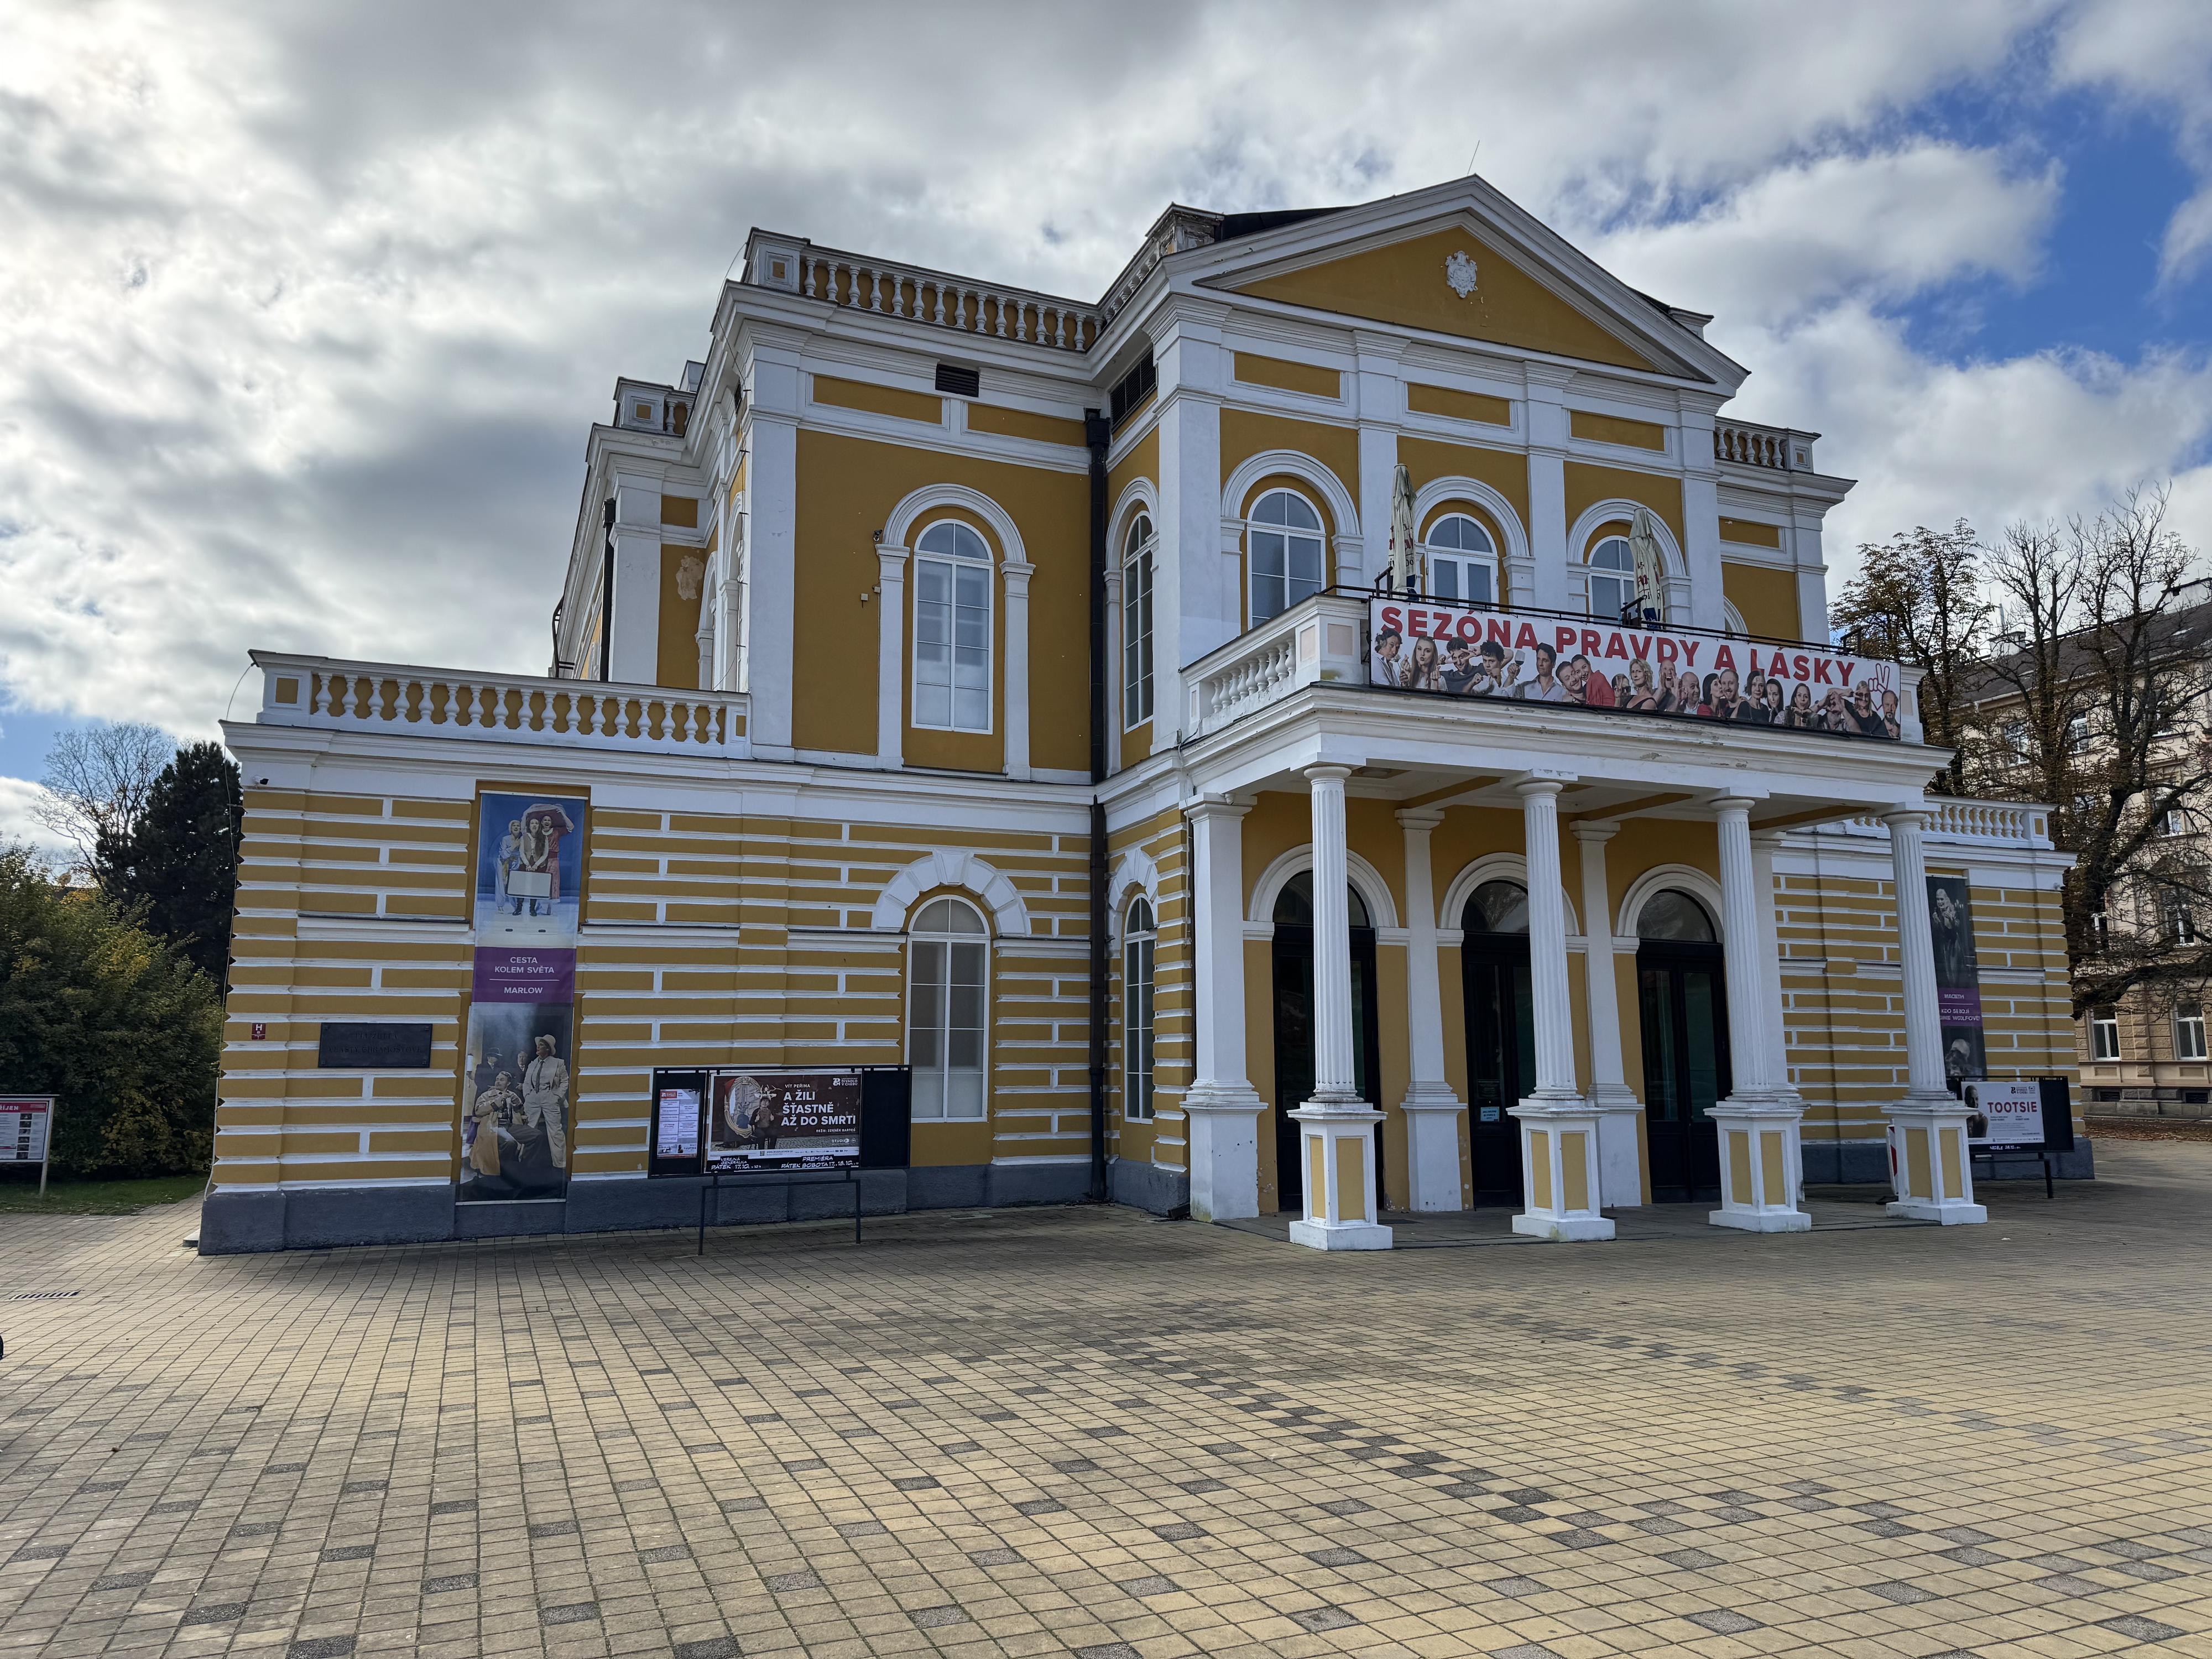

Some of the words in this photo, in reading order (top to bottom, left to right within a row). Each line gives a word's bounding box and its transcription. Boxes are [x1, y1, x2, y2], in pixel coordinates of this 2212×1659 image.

[1381, 607, 1538, 650] SEZÓNA
[1556, 626, 1700, 667] PRAVDY
[1714, 645, 1737, 671] A
[1750, 646, 1855, 686] LÁSKY
[526, 965, 555, 974] SVĚTA
[783, 1092, 792, 1101] A
[795, 1089, 815, 1100] ŽILI
[782, 1102, 834, 1114] ŠŤASTNĚ
[1987, 1102, 2037, 1113] TOOTSIE
[781, 1114, 796, 1126] AŽ
[801, 1116, 818, 1125] DO
[821, 1115, 856, 1125] SMRTI
